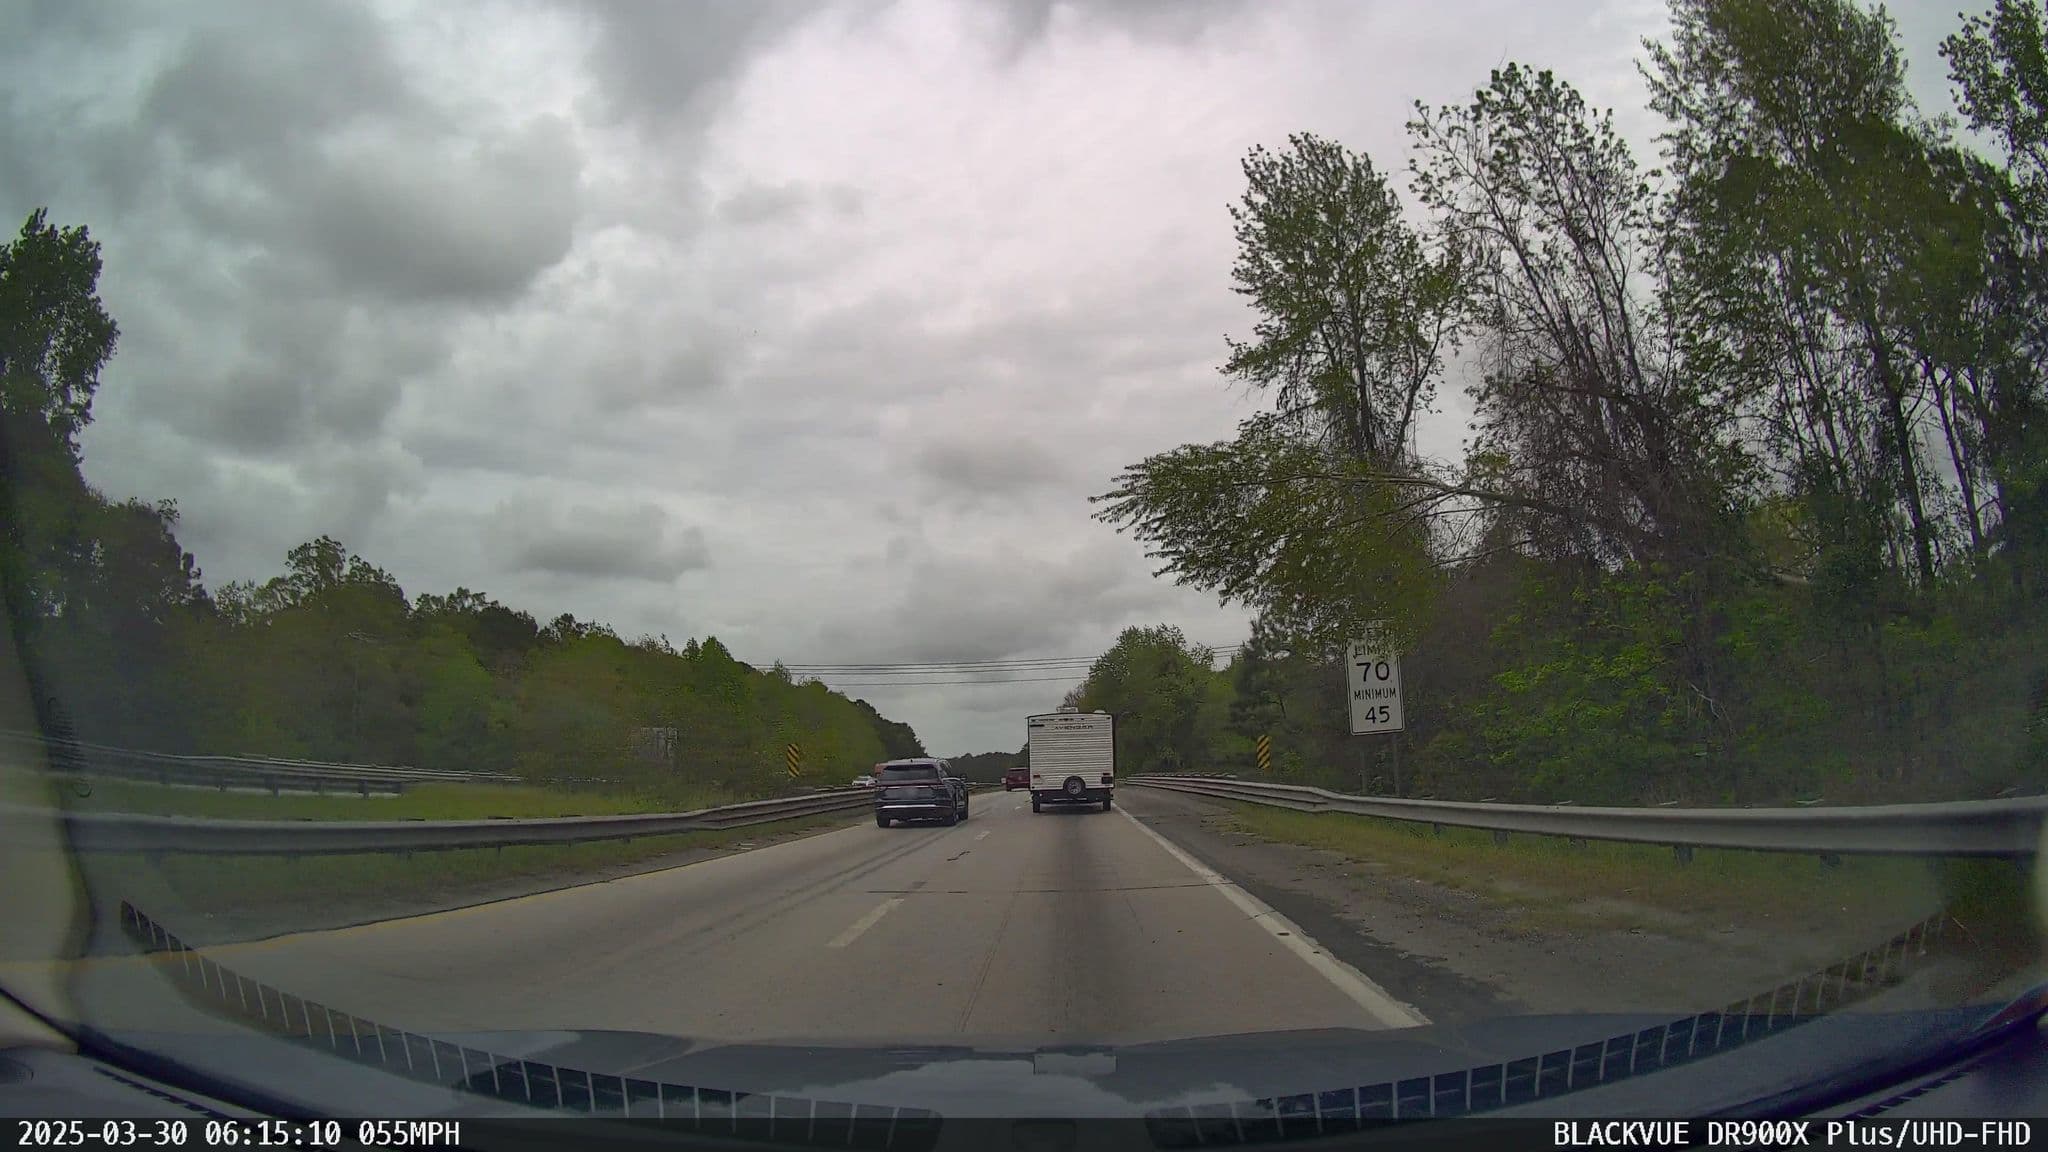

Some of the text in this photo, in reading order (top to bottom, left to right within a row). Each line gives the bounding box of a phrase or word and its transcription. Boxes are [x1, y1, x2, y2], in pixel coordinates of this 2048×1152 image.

[1356, 661, 1390, 682] 70
[1354, 687, 1397, 701] MINIMUM
[1365, 705, 1390, 724] 45
